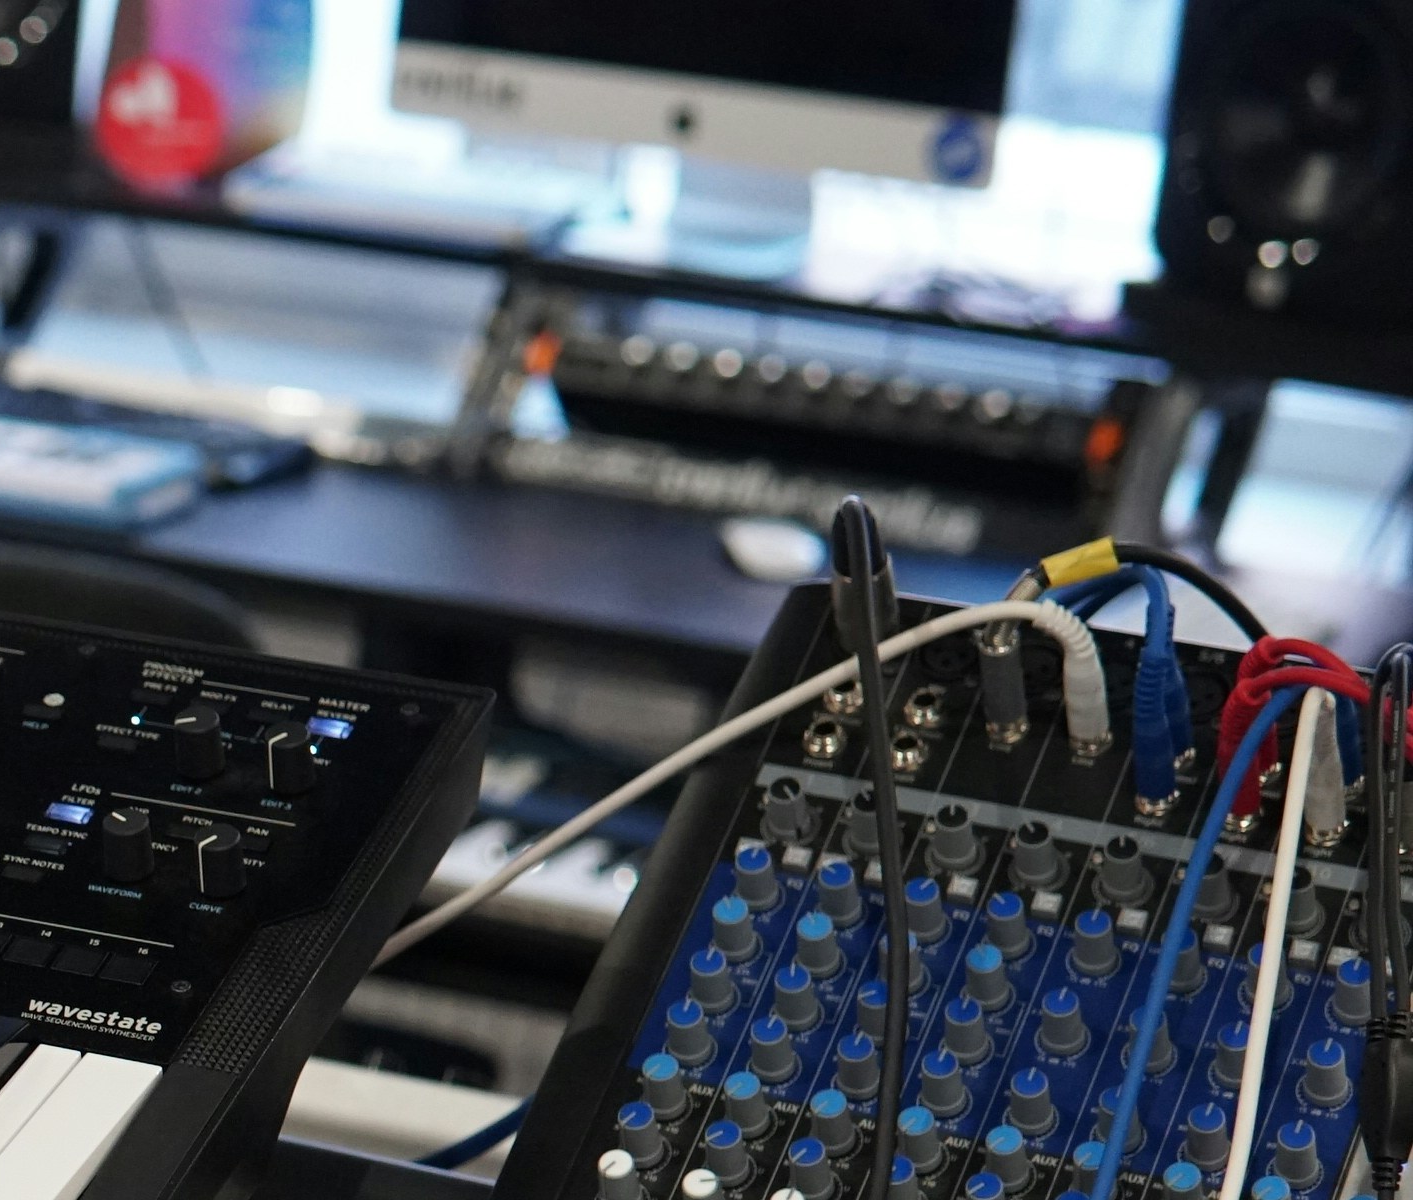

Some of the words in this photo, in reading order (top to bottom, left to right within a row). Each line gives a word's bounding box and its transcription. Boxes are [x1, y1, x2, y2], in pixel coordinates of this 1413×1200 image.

[143, 660, 204, 677] PROGRAM
[142, 668, 196, 684] EFFECTS
[261, 700, 295, 712] DELAY
[318, 696, 371, 713] MASTER
[96, 724, 133, 737] EFFECT
[135, 730, 160, 741] TYPE
[71, 783, 101, 796] LFOs
[170, 783, 193, 794] EDIT
[62, 795, 96, 807] FILTER
[260, 798, 283, 809] EDIT
[182, 815, 213, 827] PITCH
[26, 822, 59, 836] TEMPO
[61, 828, 89, 840] SYNC
[246, 826, 269, 837] PAN
[3, 854, 29, 866] SYNC
[32, 858, 65, 872] NOTES
[88, 884, 143, 900] WAVEFORM
[189, 902, 223, 914] CURVE
[138, 947, 149, 955] 16
[28, 998, 163, 1035] wavestate
[20, 1010, 43, 1022] WAVE
[44, 1015, 98, 1032] SEQUENCING
[98, 1025, 155, 1042] SYNTHESIZER
[689, 1083, 716, 1097] AUX
[774, 1101, 800, 1115] AUX
[944, 1136, 971, 1150] AUX
[1031, 1153, 1060, 1168] AUX
[1120, 1172, 1147, 1187] AUX
